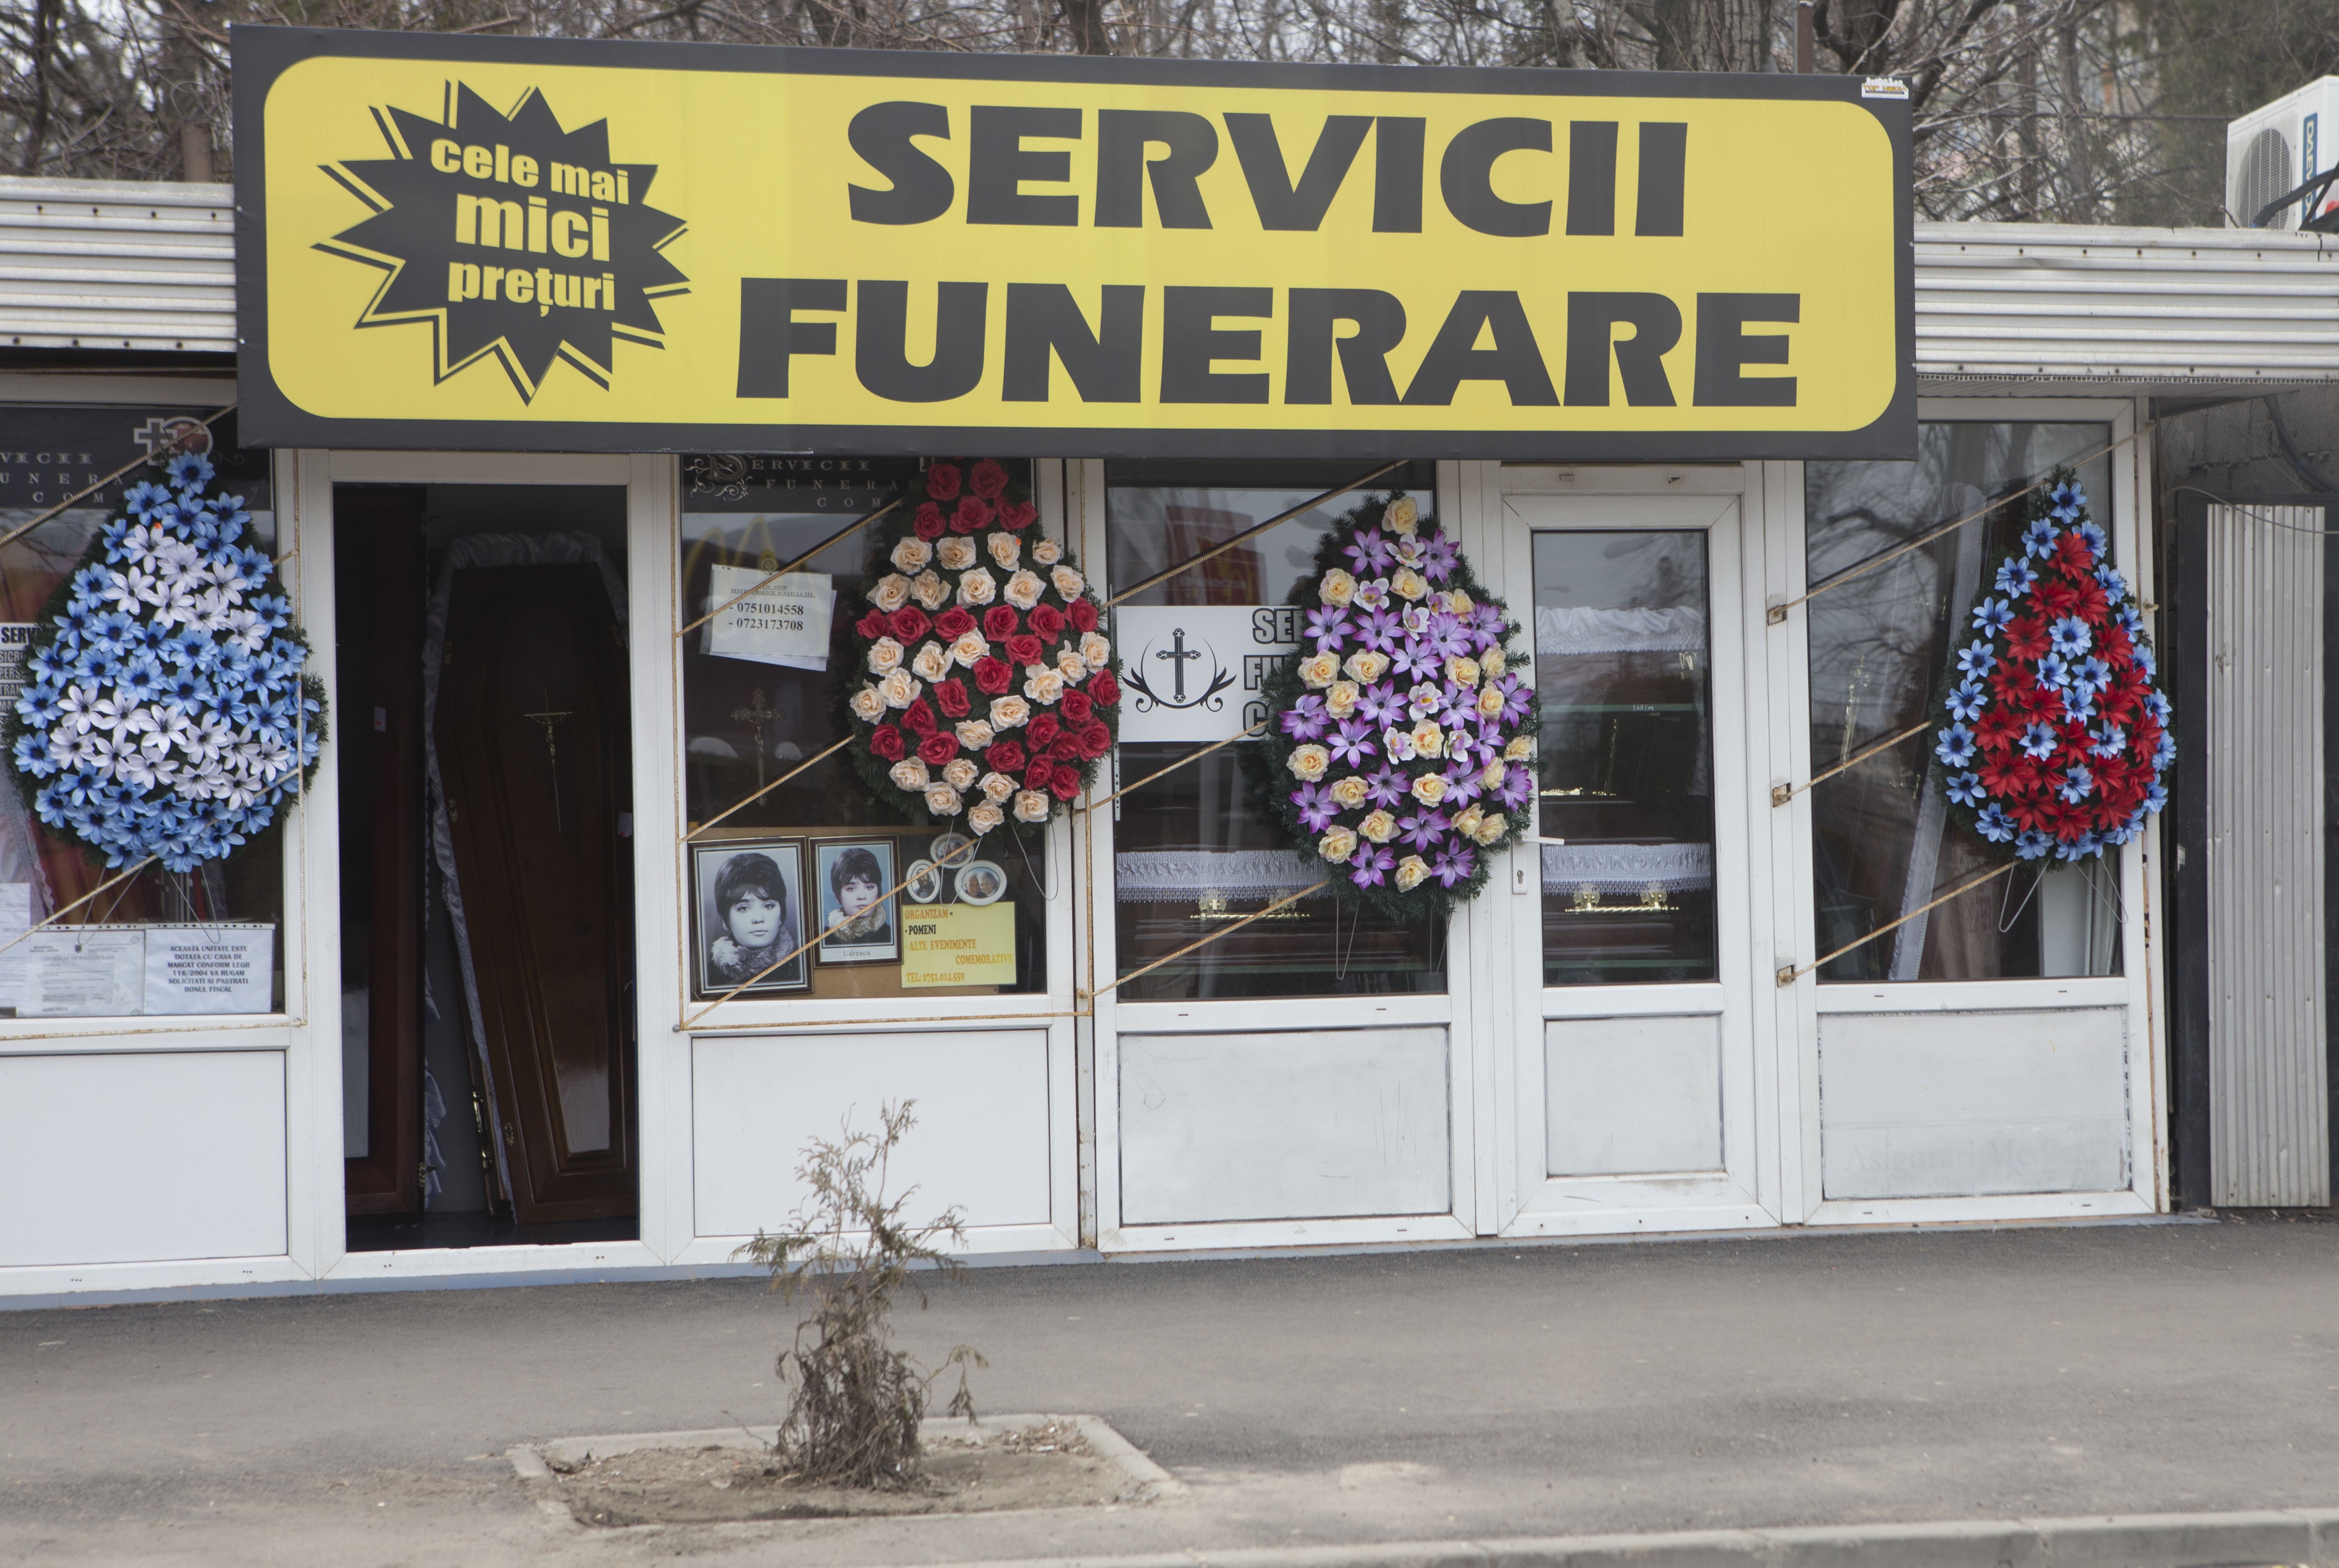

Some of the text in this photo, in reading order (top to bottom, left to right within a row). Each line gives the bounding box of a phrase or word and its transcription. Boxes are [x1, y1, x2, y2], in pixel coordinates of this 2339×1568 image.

[431, 138, 629, 205] cele mai
[848, 100, 1688, 238] SERVICII
[455, 193, 610, 262] mici
[736, 277, 1801, 408] FUNERARE
[766, 479, 915, 490] FUNERA
[737, 602, 804, 615] 0751014558
[736, 618, 803, 631] 0723173708
[905, 909, 948, 920] ORGANIZAM
[909, 924, 936, 935] POMENI
[909, 939, 976, 951] ALTE EVENIMENTE
[956, 954, 1013, 965] COMEMORATIVE
[906, 972, 965, 983] TEL: 0751.014.559
